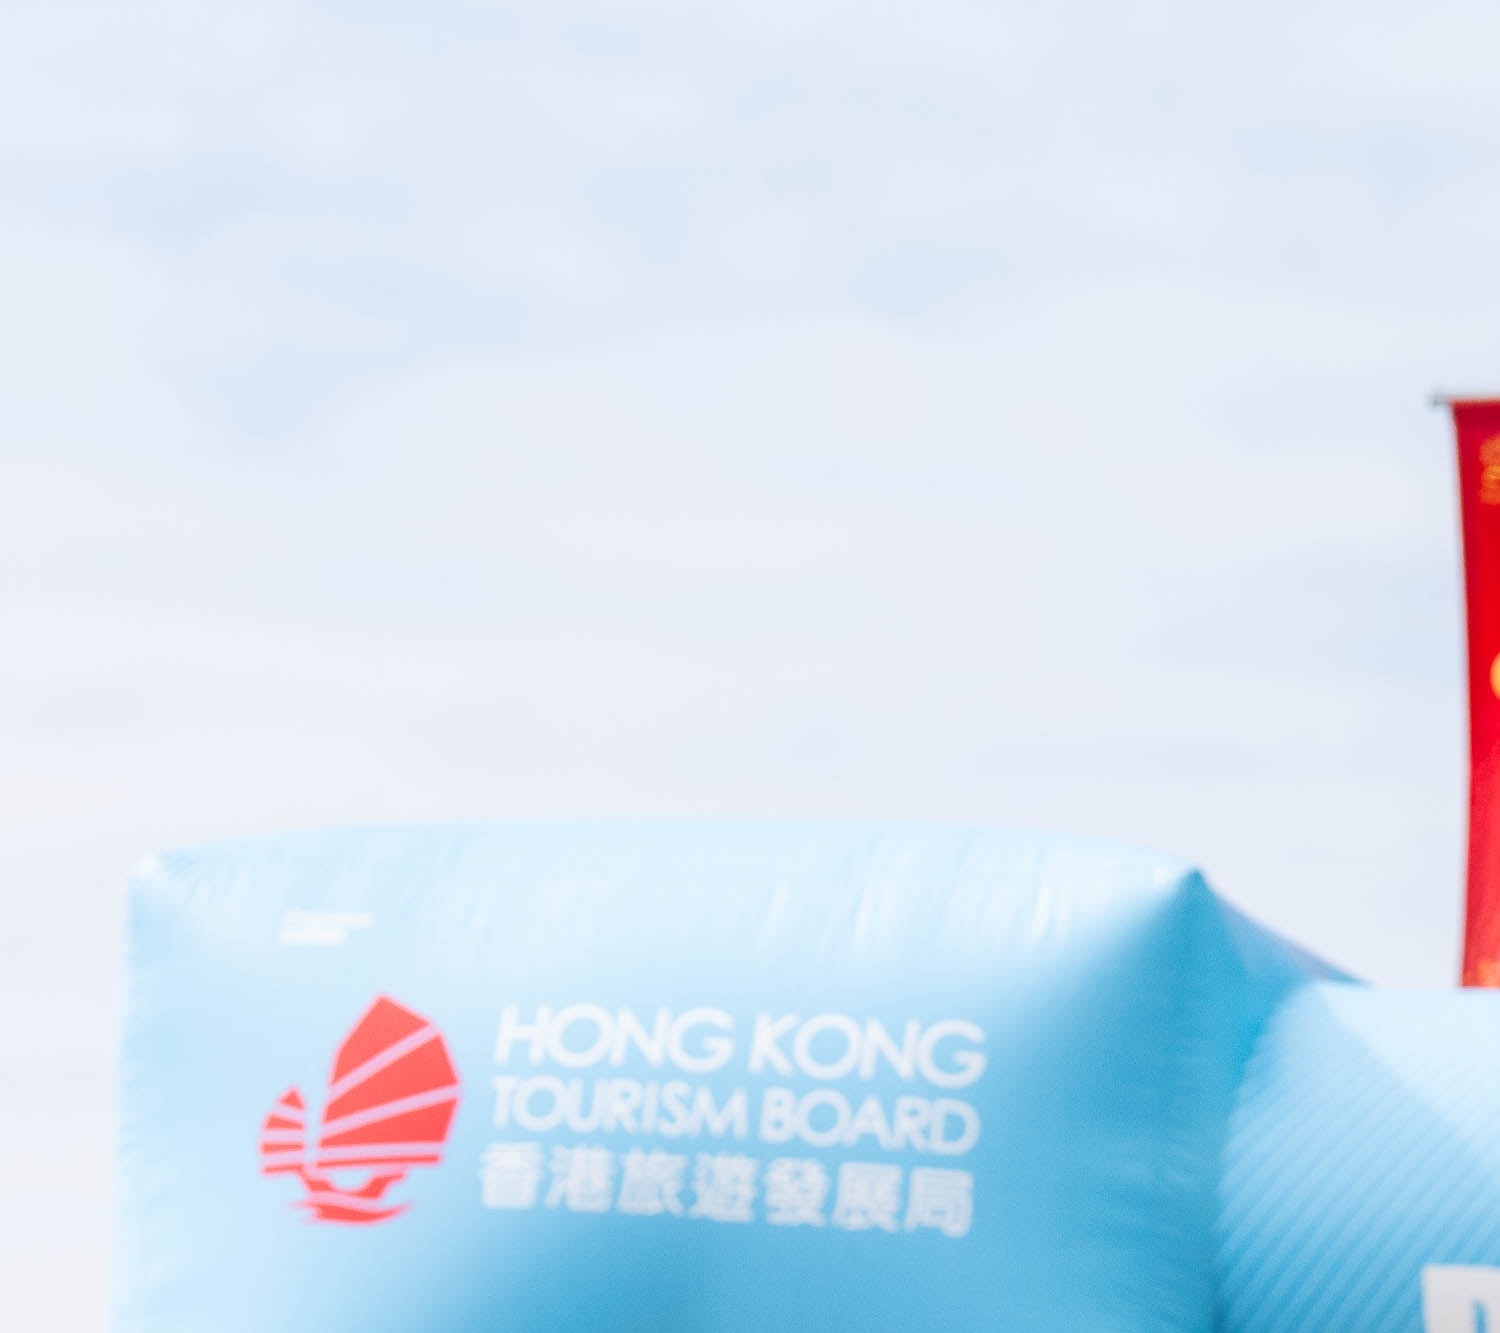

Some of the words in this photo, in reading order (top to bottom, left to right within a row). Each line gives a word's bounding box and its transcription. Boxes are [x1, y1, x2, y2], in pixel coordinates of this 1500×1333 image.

[494, 1003, 736, 1073] HONG
[748, 1012, 988, 1090] KONG
[491, 1075, 749, 1142] TOURISM
[758, 1087, 982, 1157] BOARD
